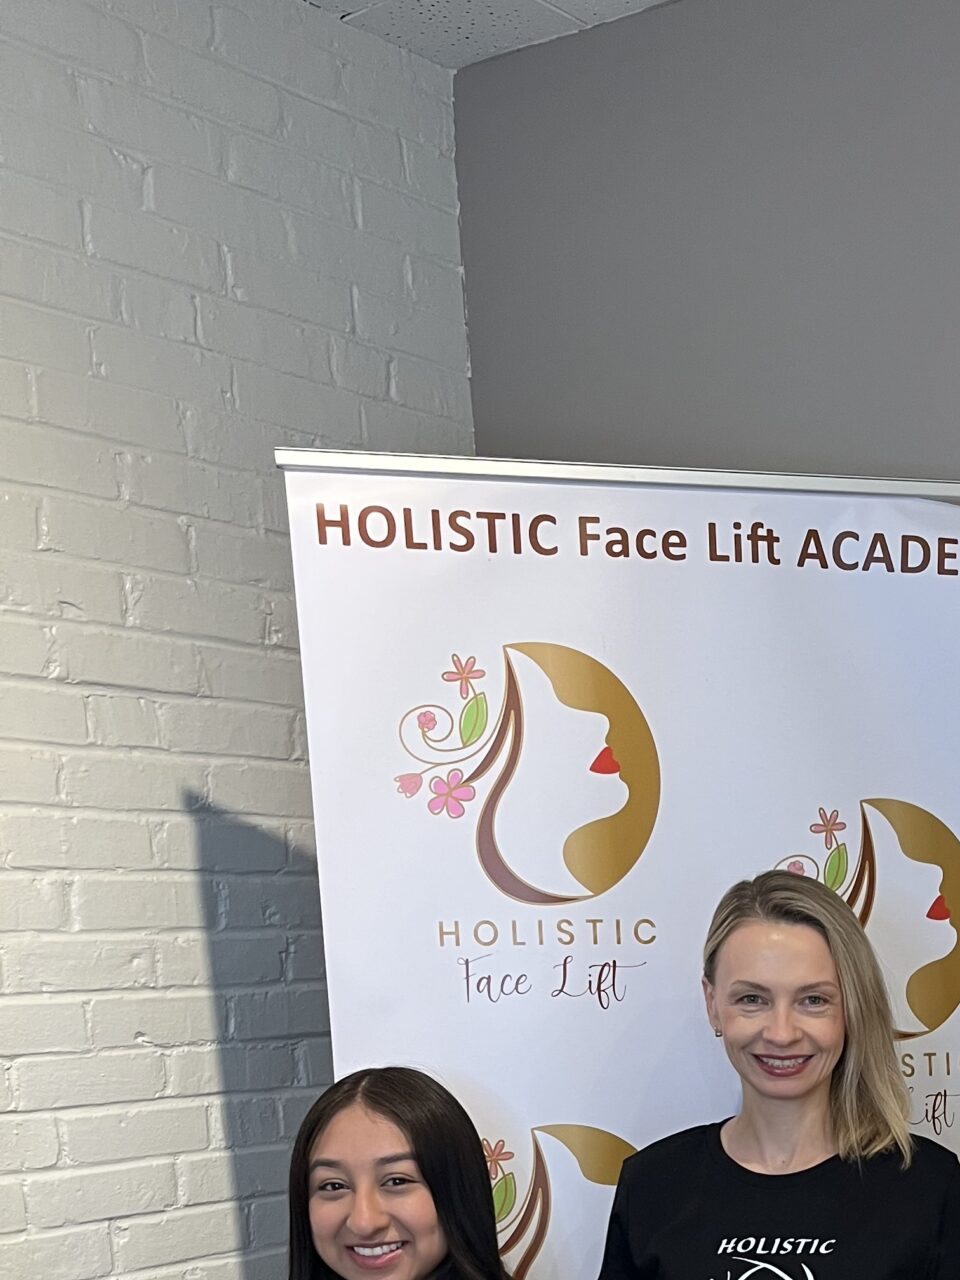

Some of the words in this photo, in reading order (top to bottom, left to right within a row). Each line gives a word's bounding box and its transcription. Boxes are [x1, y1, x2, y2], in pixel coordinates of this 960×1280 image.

[316, 503, 558, 556] HOLISTIC
[578, 516, 687, 560] Face
[708, 521, 781, 566] Lift
[438, 918, 657, 947] HOLISTIC
[457, 953, 532, 1003] Face
[551, 955, 647, 1010] Lift
[717, 1237, 836, 1254] HOLISTIC
